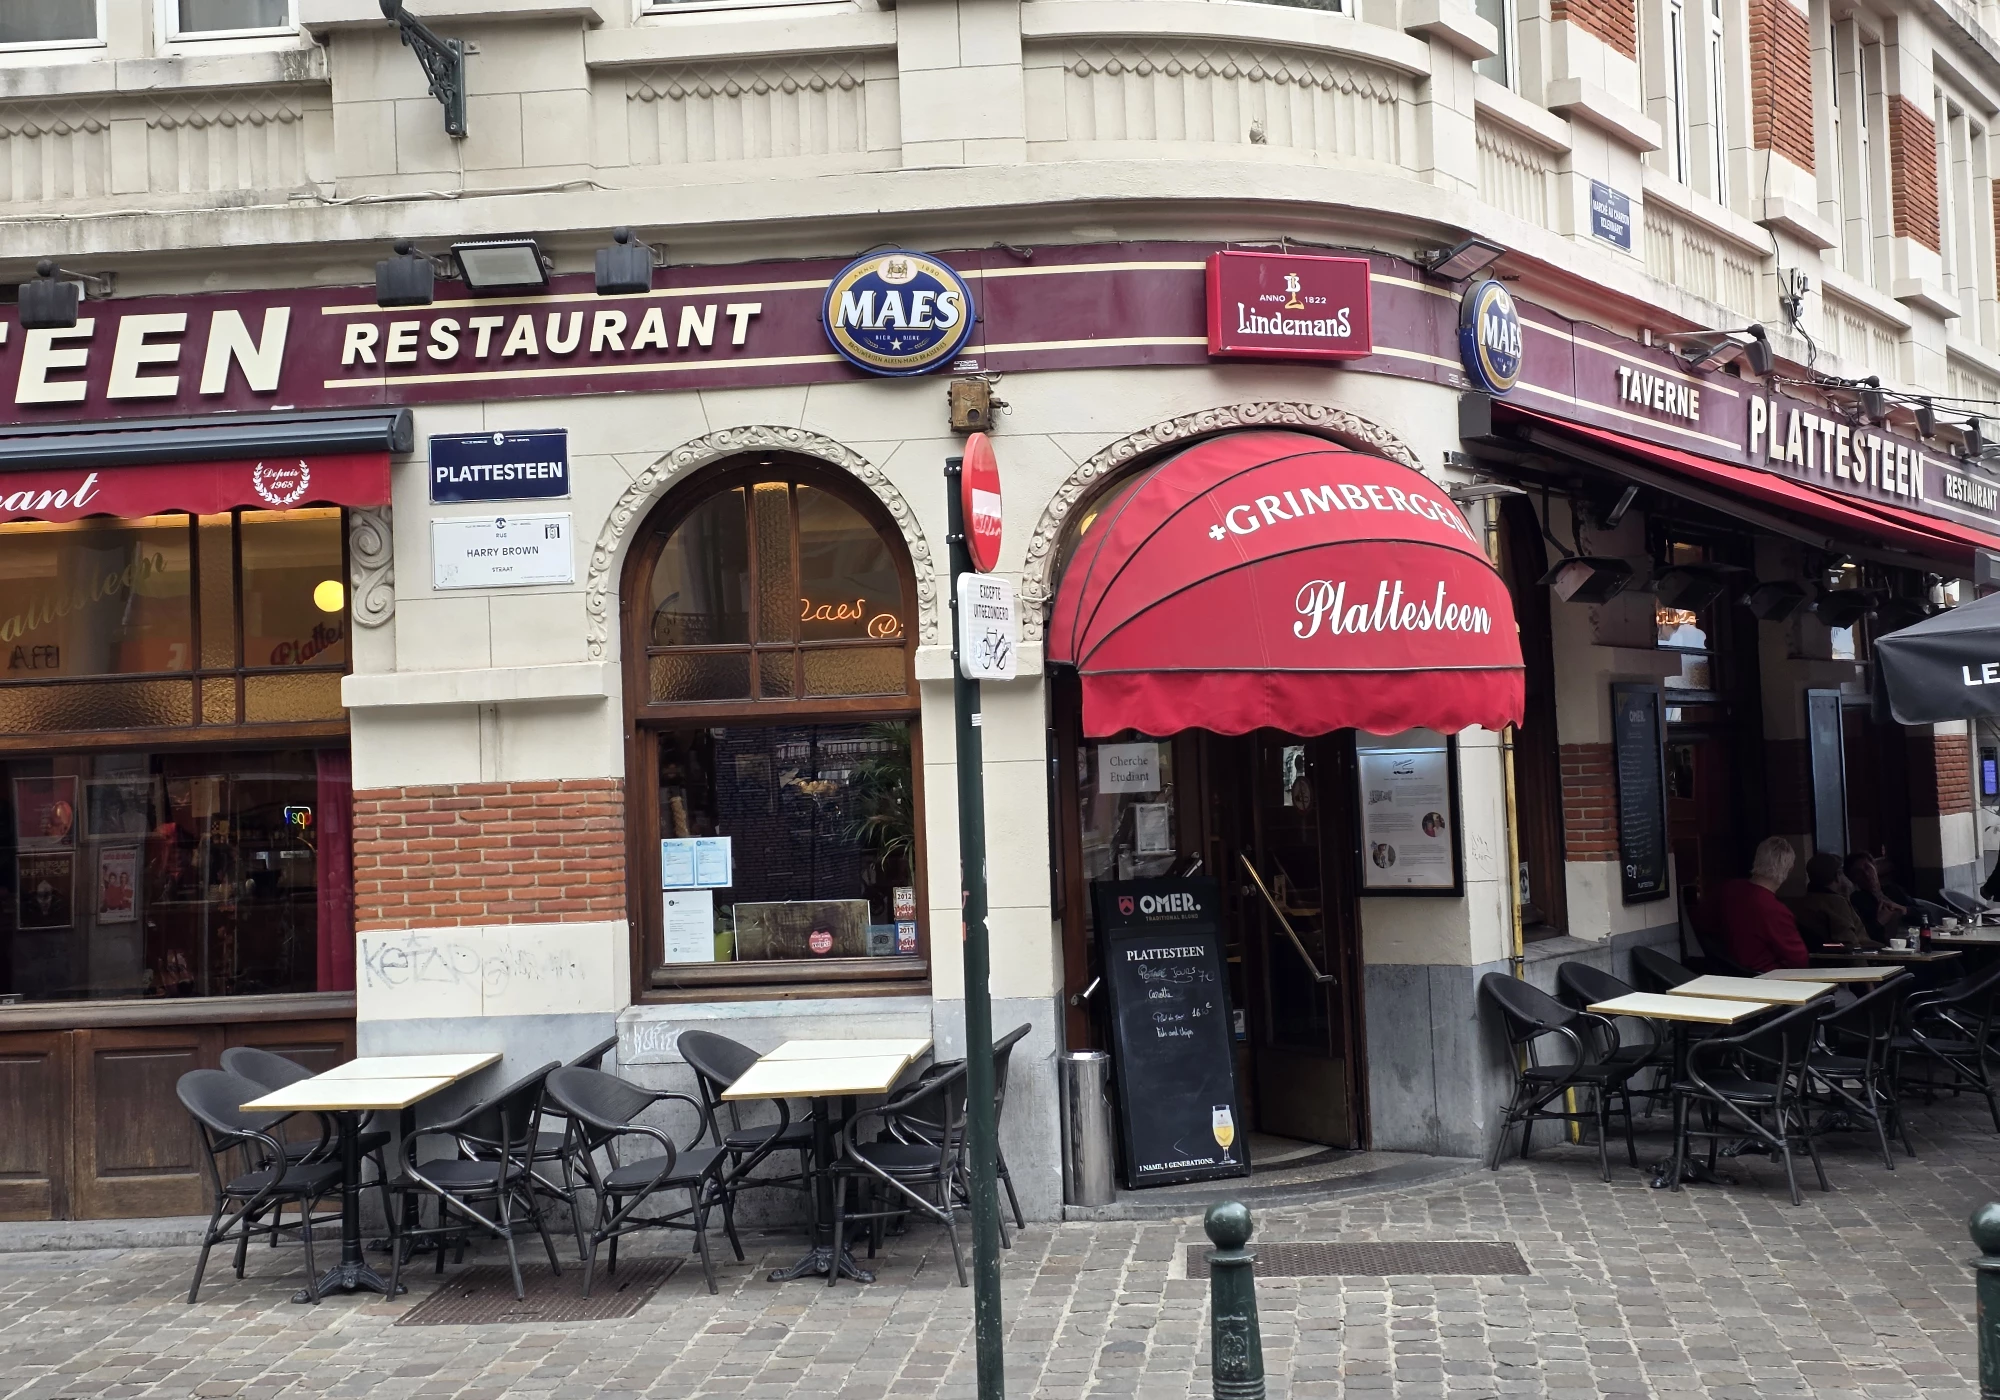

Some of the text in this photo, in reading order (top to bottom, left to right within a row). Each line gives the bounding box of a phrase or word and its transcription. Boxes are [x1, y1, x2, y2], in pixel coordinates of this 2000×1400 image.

[1259, 294, 1327, 304] ANNO 1822
[835, 290, 961, 331] MAES
[341, 302, 762, 366] RESTAURANT
[1481, 312, 1522, 359] MAES
[0, 306, 290, 404] EEN
[1619, 366, 1700, 421] TAVERNE
[1751, 395, 1925, 501] PLATTESTEEN
[263, 467, 300, 480] Depuis
[436, 461, 563, 483] PLATTESTEEN
[270, 480, 294, 490] 1968
[1946, 473, 1998, 512] RESTAURANT
[467, 546, 539, 558] HARRY BROWN
[1293, 579, 1492, 639] Plattesteen
[1109, 755, 1149, 767] Cherche
[1110, 771, 1150, 783] Etudiant
[1139, 893, 1202, 914] OMER.
[1146, 914, 1180, 922] TRADITIONAL
[1126, 945, 1205, 962] PLATTESTEEN
[1143, 1163, 1164, 1172] NAME,
